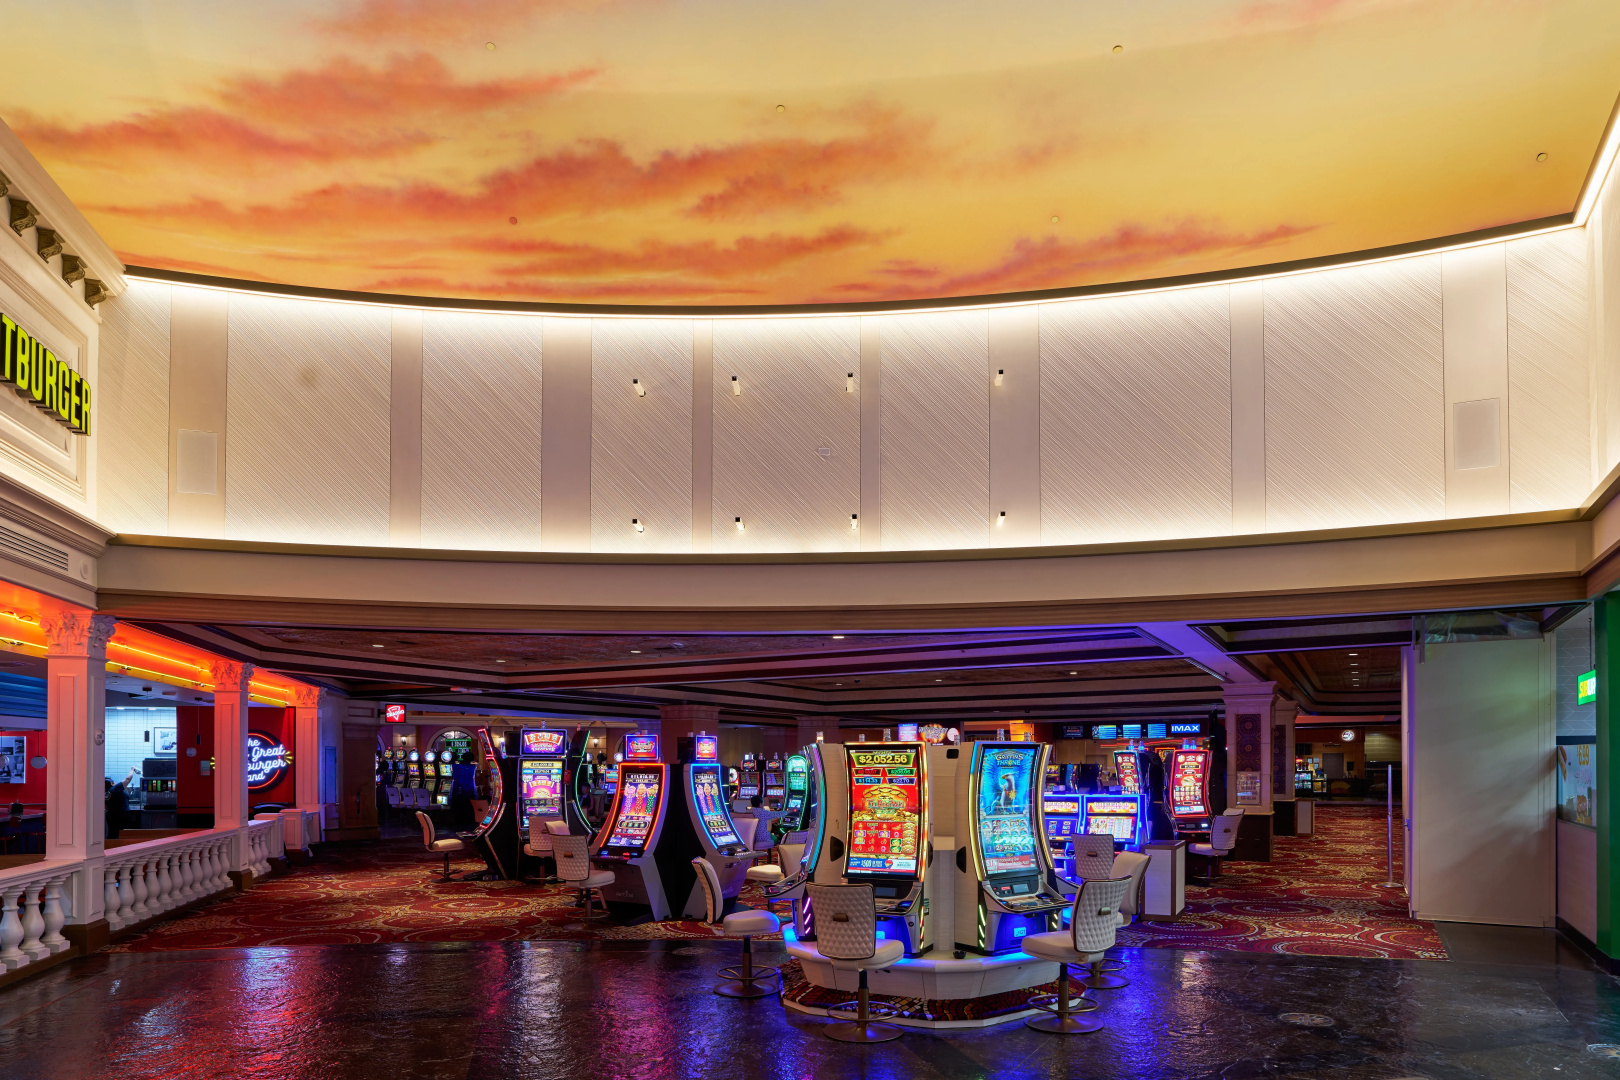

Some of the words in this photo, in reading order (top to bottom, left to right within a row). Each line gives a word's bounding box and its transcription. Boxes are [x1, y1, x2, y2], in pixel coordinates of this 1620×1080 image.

[1579, 677, 1596, 699] SUBWA
[1171, 724, 1200, 732] IMAX
[248, 738, 260, 747] he
[252, 744, 285, 762] Great
[858, 754, 908, 765] $2,052.56
